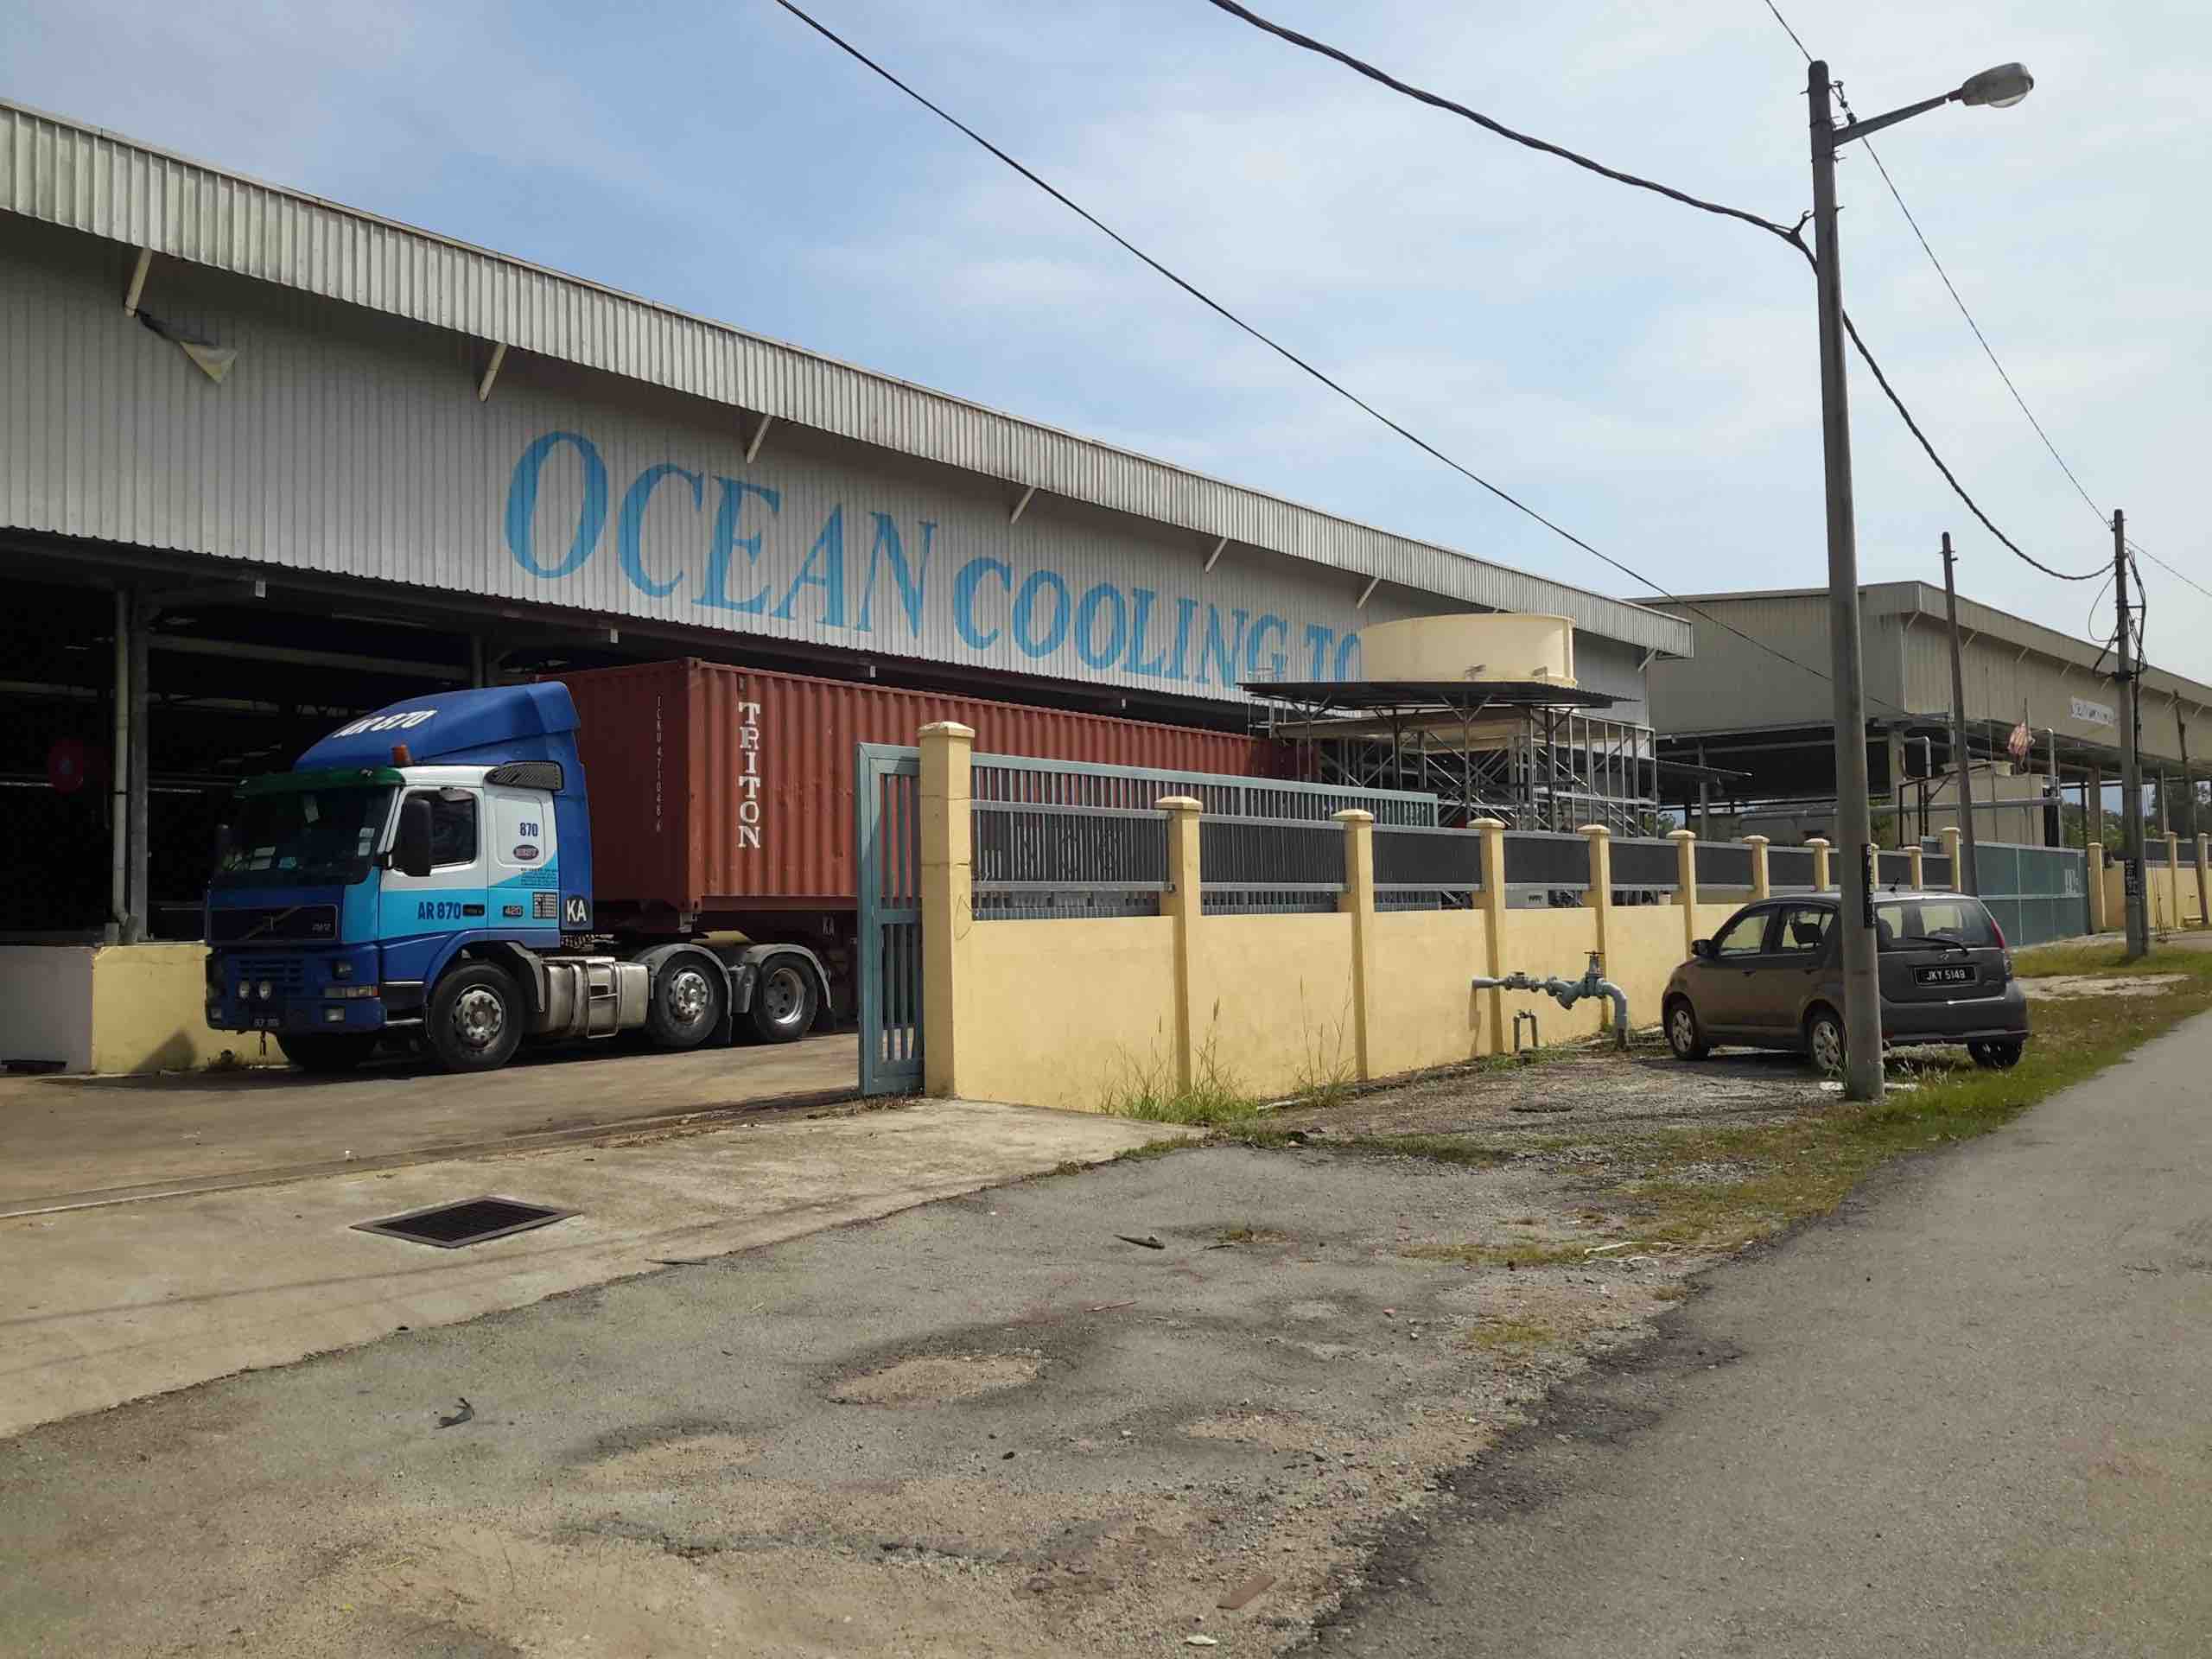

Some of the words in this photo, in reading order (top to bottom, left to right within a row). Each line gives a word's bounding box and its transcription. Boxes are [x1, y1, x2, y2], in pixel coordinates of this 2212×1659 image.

[504, 431, 938, 639] OCEAN
[952, 556, 1288, 691] COOLING
[738, 701, 761, 849] TRITON
[519, 822, 538, 837] 870
[417, 901, 435, 920] AR
[436, 901, 462, 920] 870
[566, 899, 587, 922] KA
[1944, 969, 1966, 980] 5149
